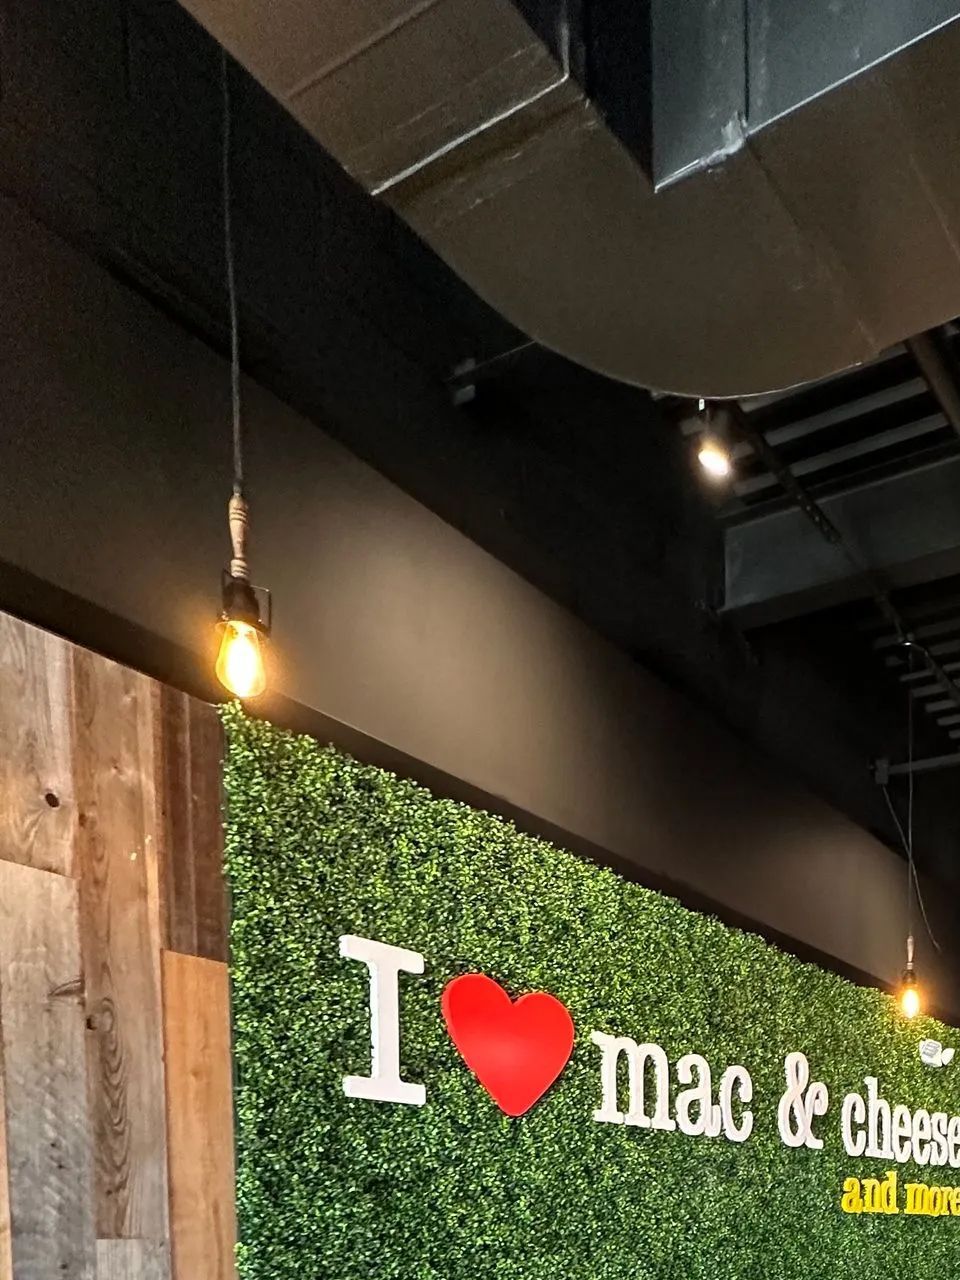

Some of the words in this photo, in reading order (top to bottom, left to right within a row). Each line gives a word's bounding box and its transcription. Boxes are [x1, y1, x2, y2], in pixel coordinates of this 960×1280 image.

[339, 934, 427, 1106] I
[591, 1030, 754, 1142] mac
[778, 1051, 829, 1149] &
[841, 1171, 899, 1214] and
